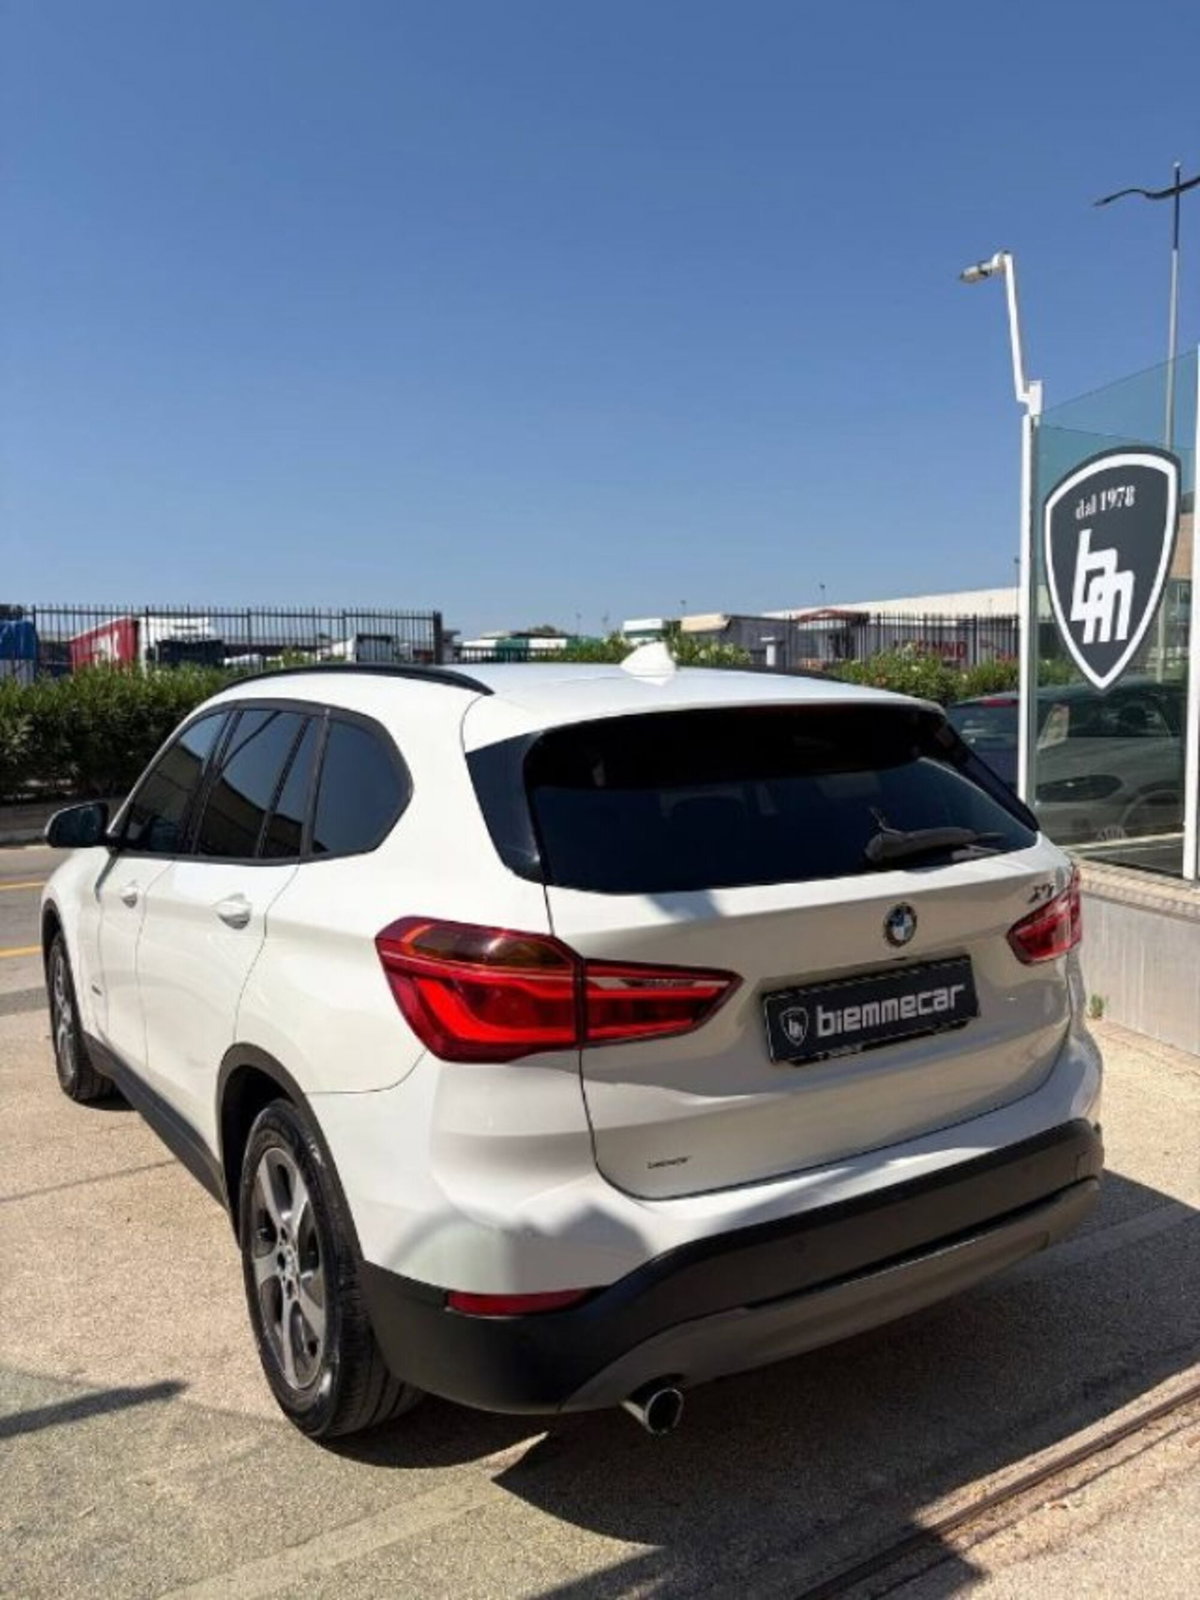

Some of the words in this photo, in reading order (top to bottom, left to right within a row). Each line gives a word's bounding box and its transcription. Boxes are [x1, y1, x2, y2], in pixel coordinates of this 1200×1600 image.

[1076, 493, 1096, 520] dal
[1101, 485, 1135, 511] 1978
[816, 984, 965, 1038] biemmecar
